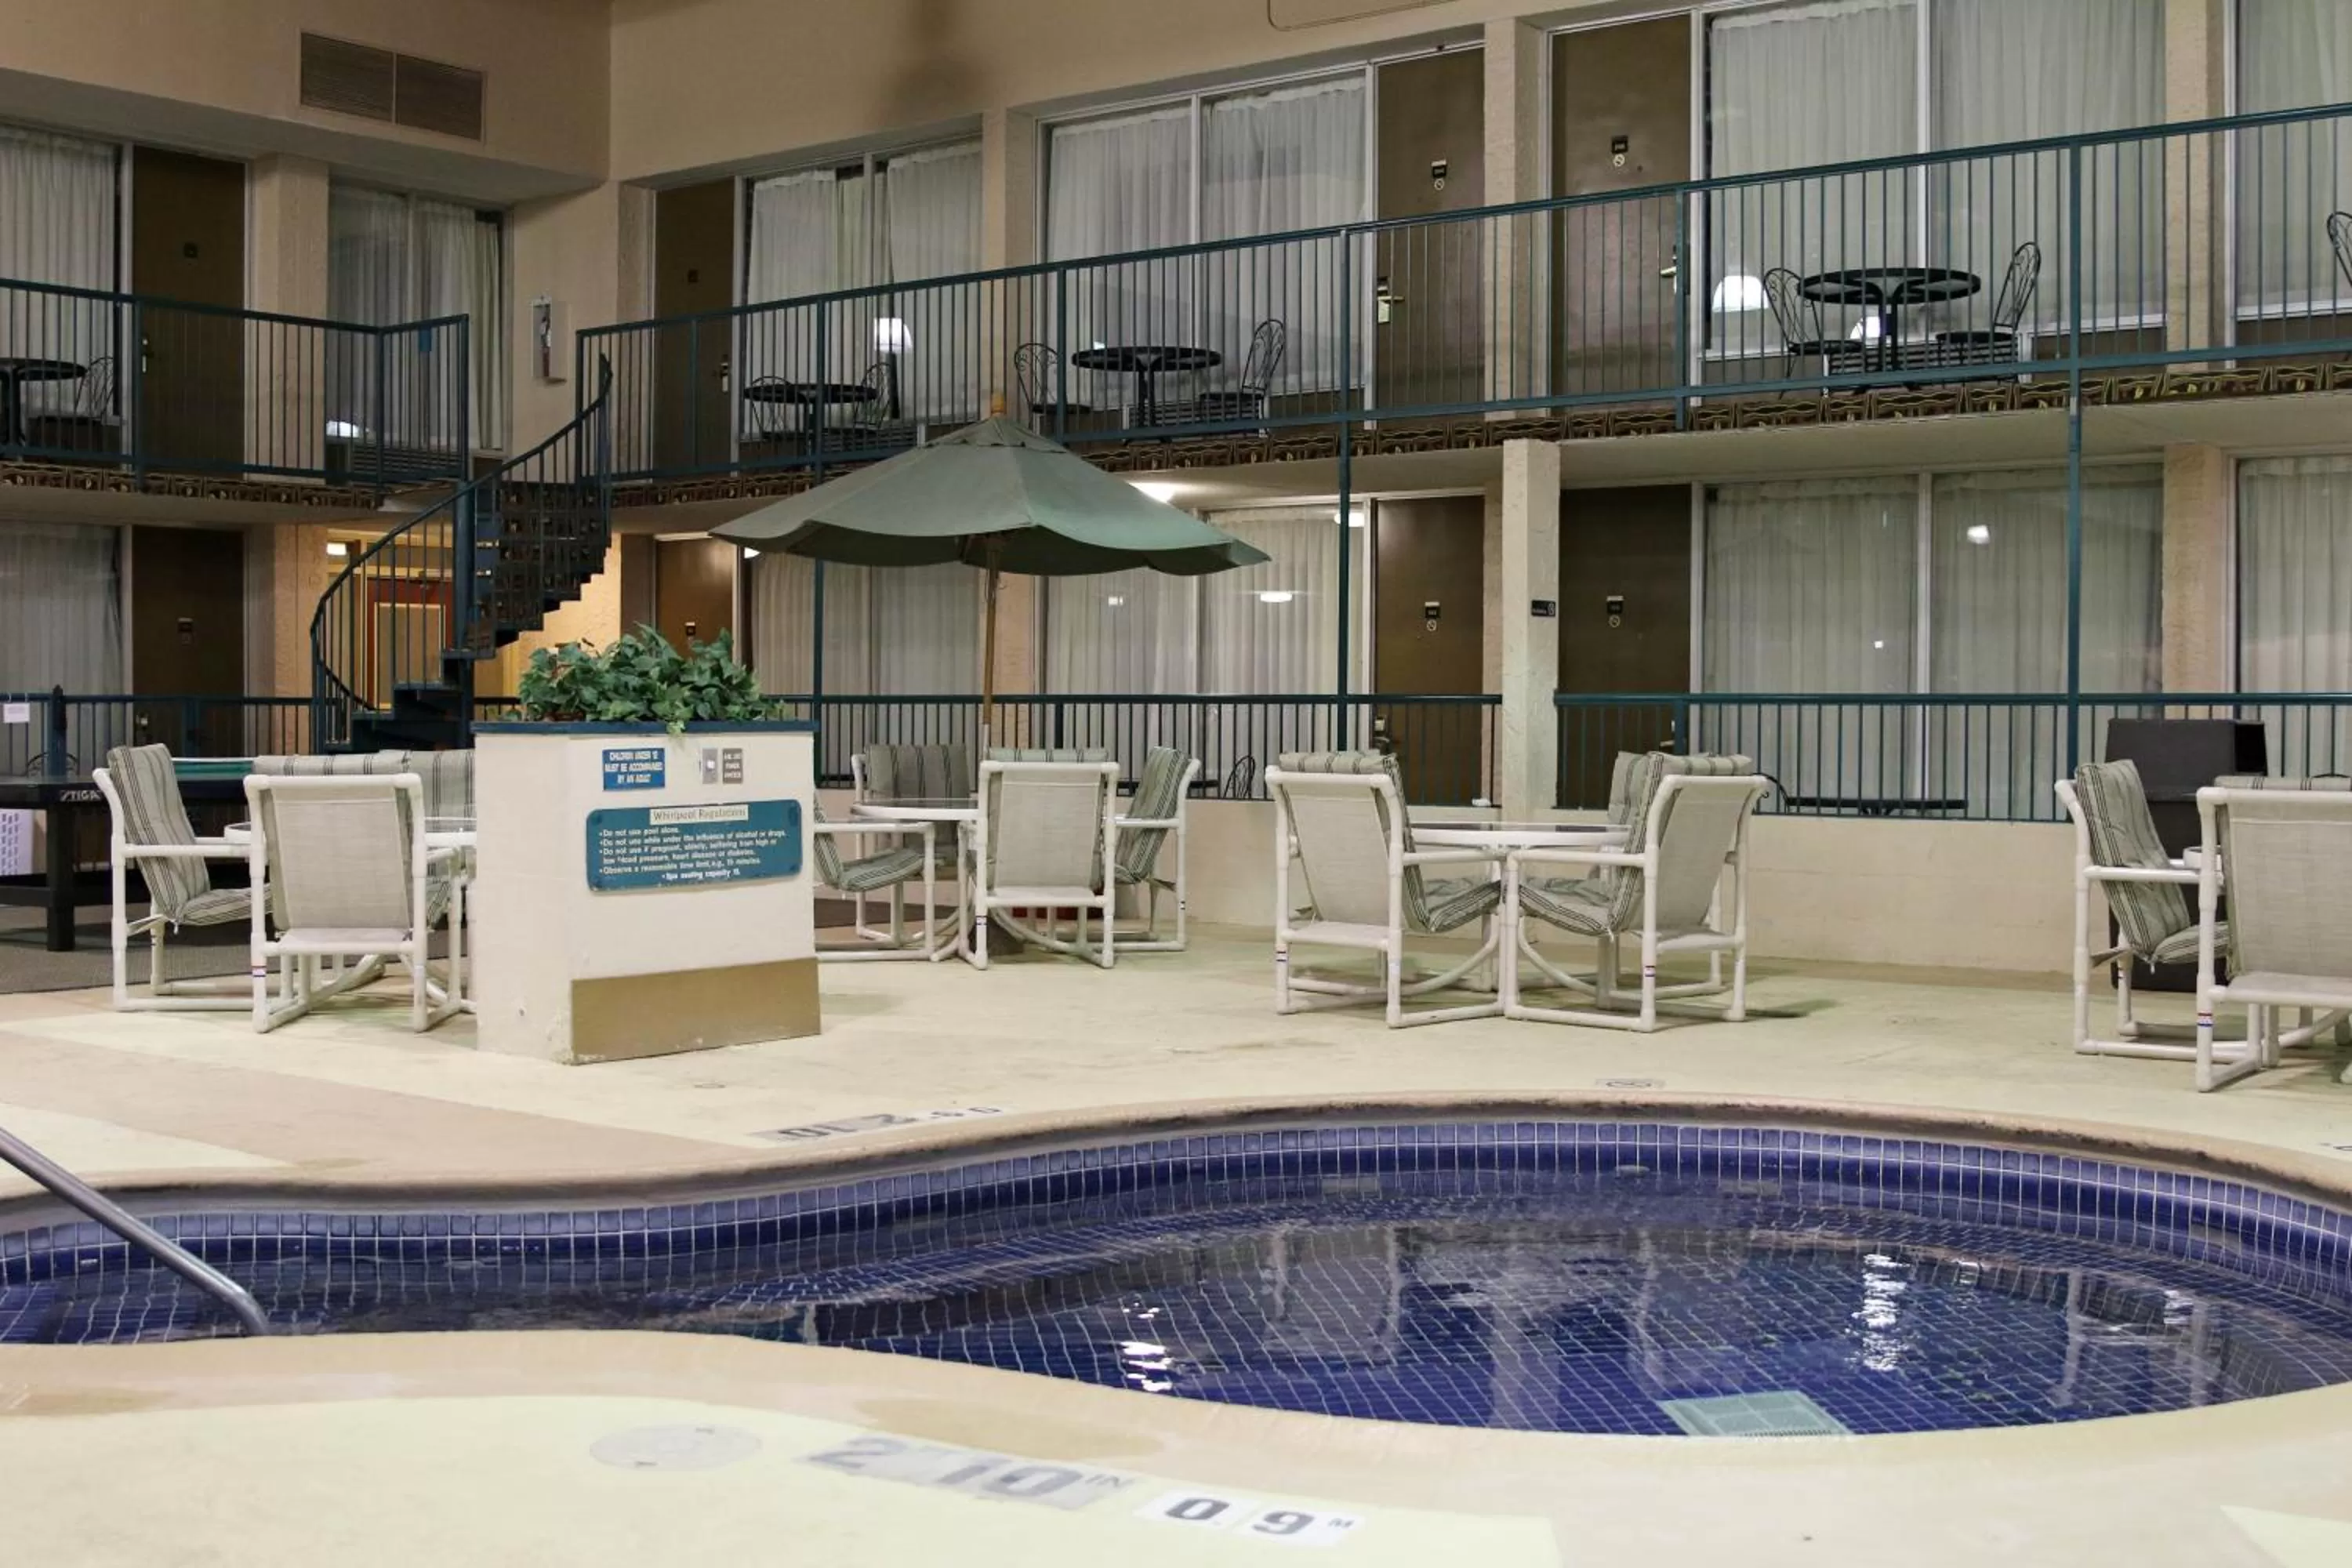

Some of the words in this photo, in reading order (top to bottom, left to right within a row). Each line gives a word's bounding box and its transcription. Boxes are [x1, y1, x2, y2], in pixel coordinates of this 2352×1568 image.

[653, 810, 696, 822] Whirlpool
[808, 1434, 908, 1469] 2
[935, 1456, 1083, 1497] 10
[1252, 1510, 1315, 1534] 9
